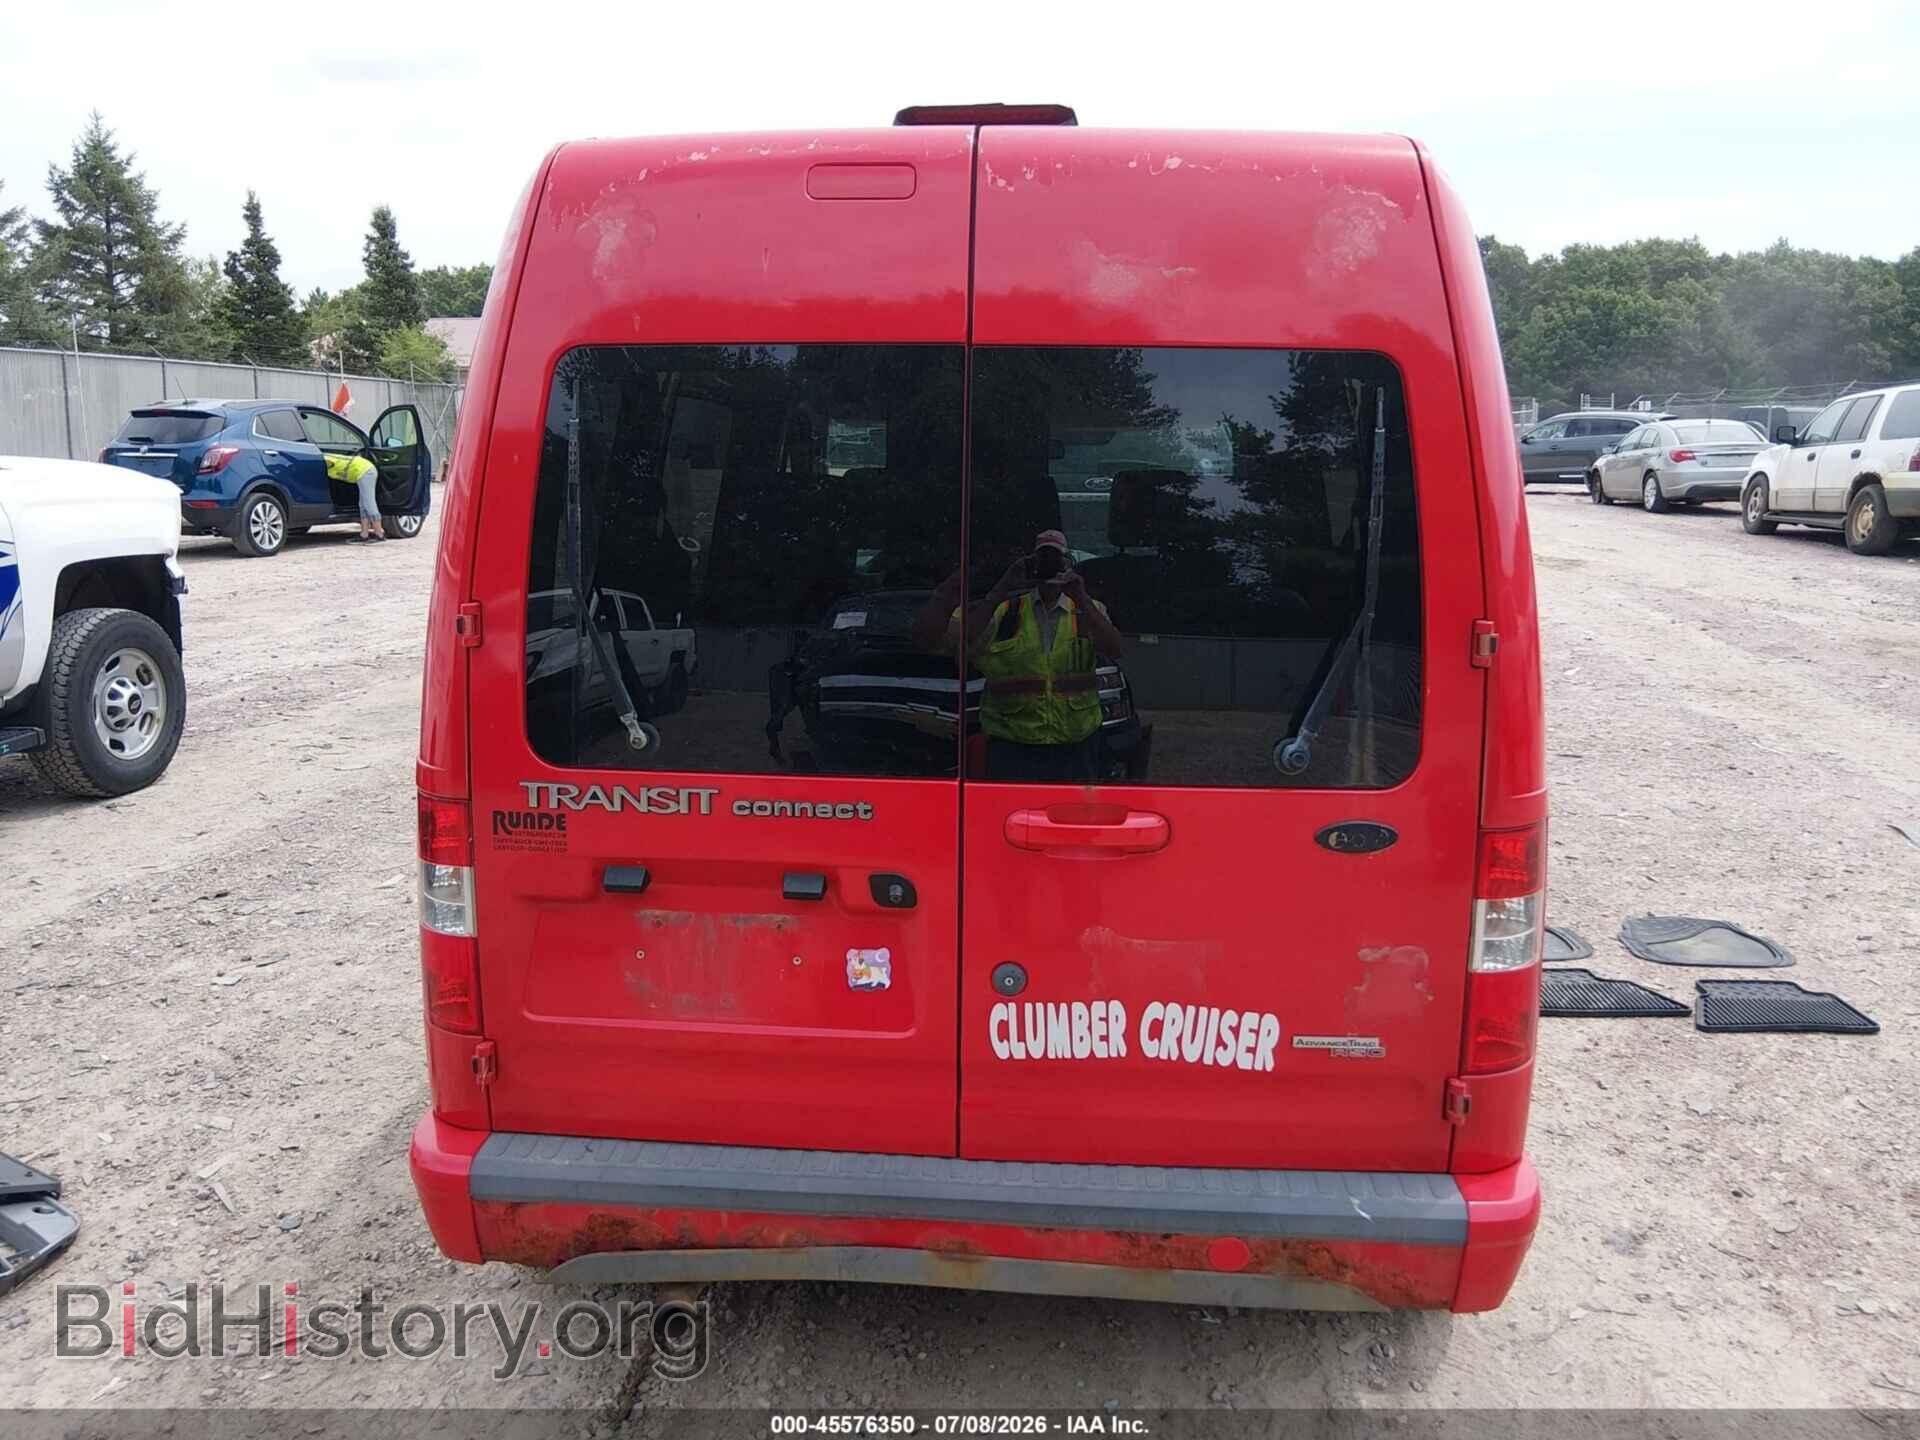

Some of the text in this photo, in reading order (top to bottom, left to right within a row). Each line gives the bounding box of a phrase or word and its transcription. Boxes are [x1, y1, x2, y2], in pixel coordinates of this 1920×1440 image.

[519, 781, 874, 820] TRANSIT connect
[492, 810, 567, 835] RUNDE
[989, 1000, 1281, 1072] CLUMBER CRUISER
